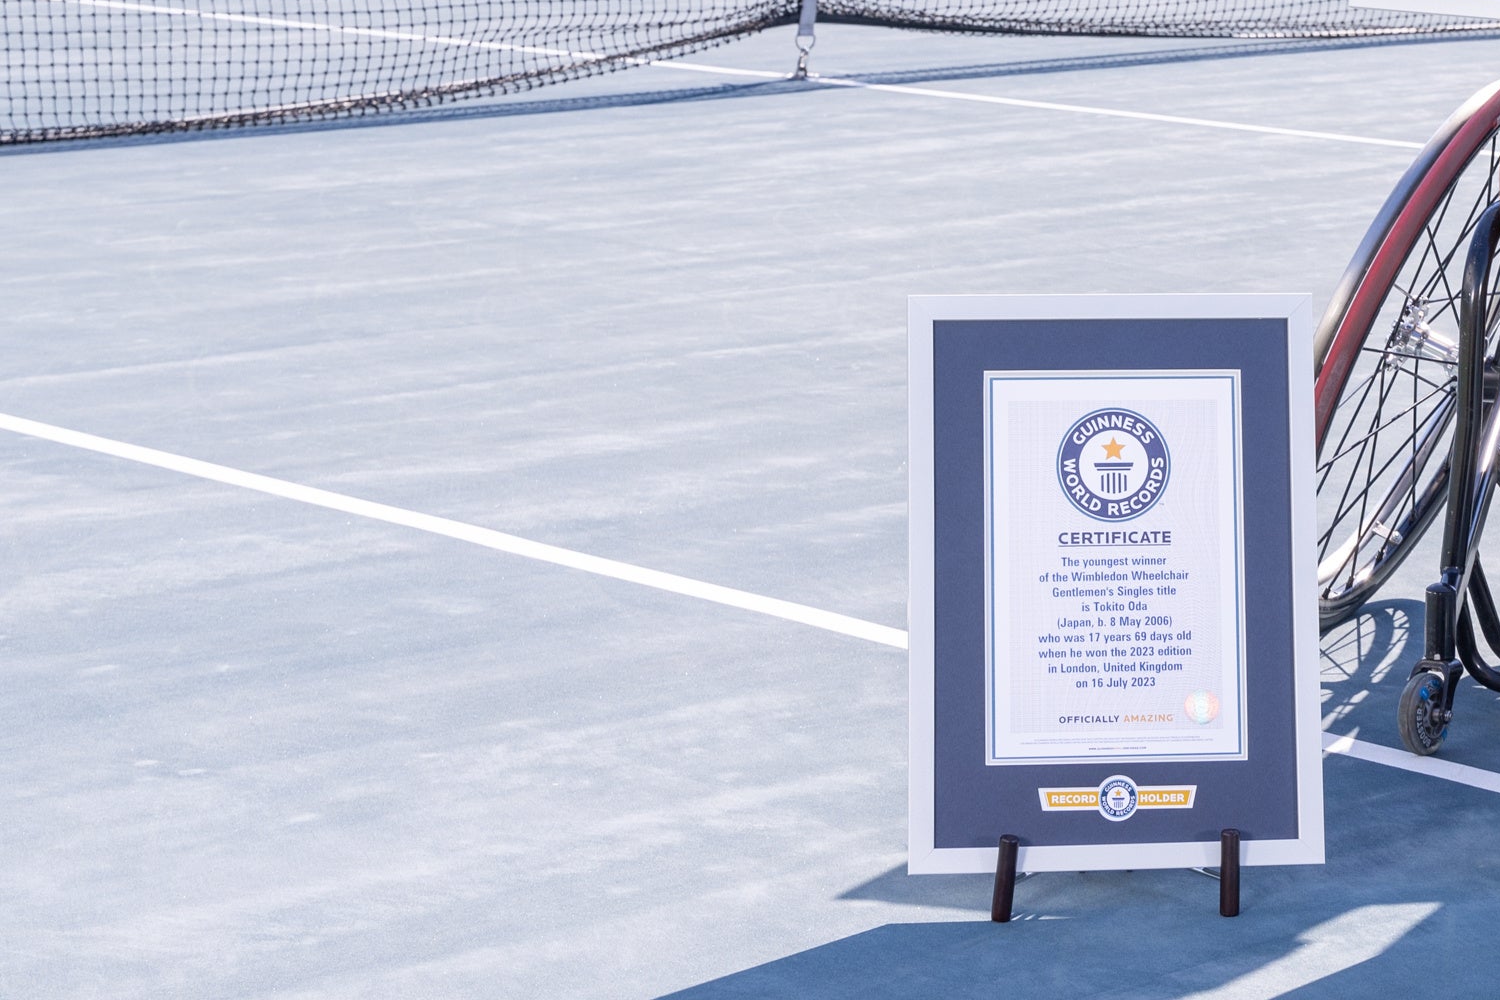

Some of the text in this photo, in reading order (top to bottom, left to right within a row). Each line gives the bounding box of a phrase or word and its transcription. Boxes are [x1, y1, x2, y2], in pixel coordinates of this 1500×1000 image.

[1072, 414, 1155, 445] GUINNESS
[1063, 457, 1164, 516] WORLD RECORDS
[1058, 530, 1172, 545] CERTIFICATE
[1061, 555, 1167, 569] The youngest winner
[1039, 570, 1189, 583] of the Wimbledon Wheelchair
[1052, 585, 1177, 599] Gentlemen's Singles title
[1081, 600, 1148, 612] is Tokito Oda
[1057, 615, 1173, 630] (Japan, b. 8 May 2006)
[1038, 630, 1192, 644] who was 17 years 69 days old
[1038, 645, 1192, 659] when he won the 2023 edition
[1048, 661, 1183, 674] in London, United Kingdom
[1075, 676, 1156, 690] on 16 July 2023
[1058, 714, 1173, 724] OFFICIALLY AMAZING
[1416, 708, 1431, 747] BOOSTER
[1051, 793, 1185, 804] RECORD HOLDER
